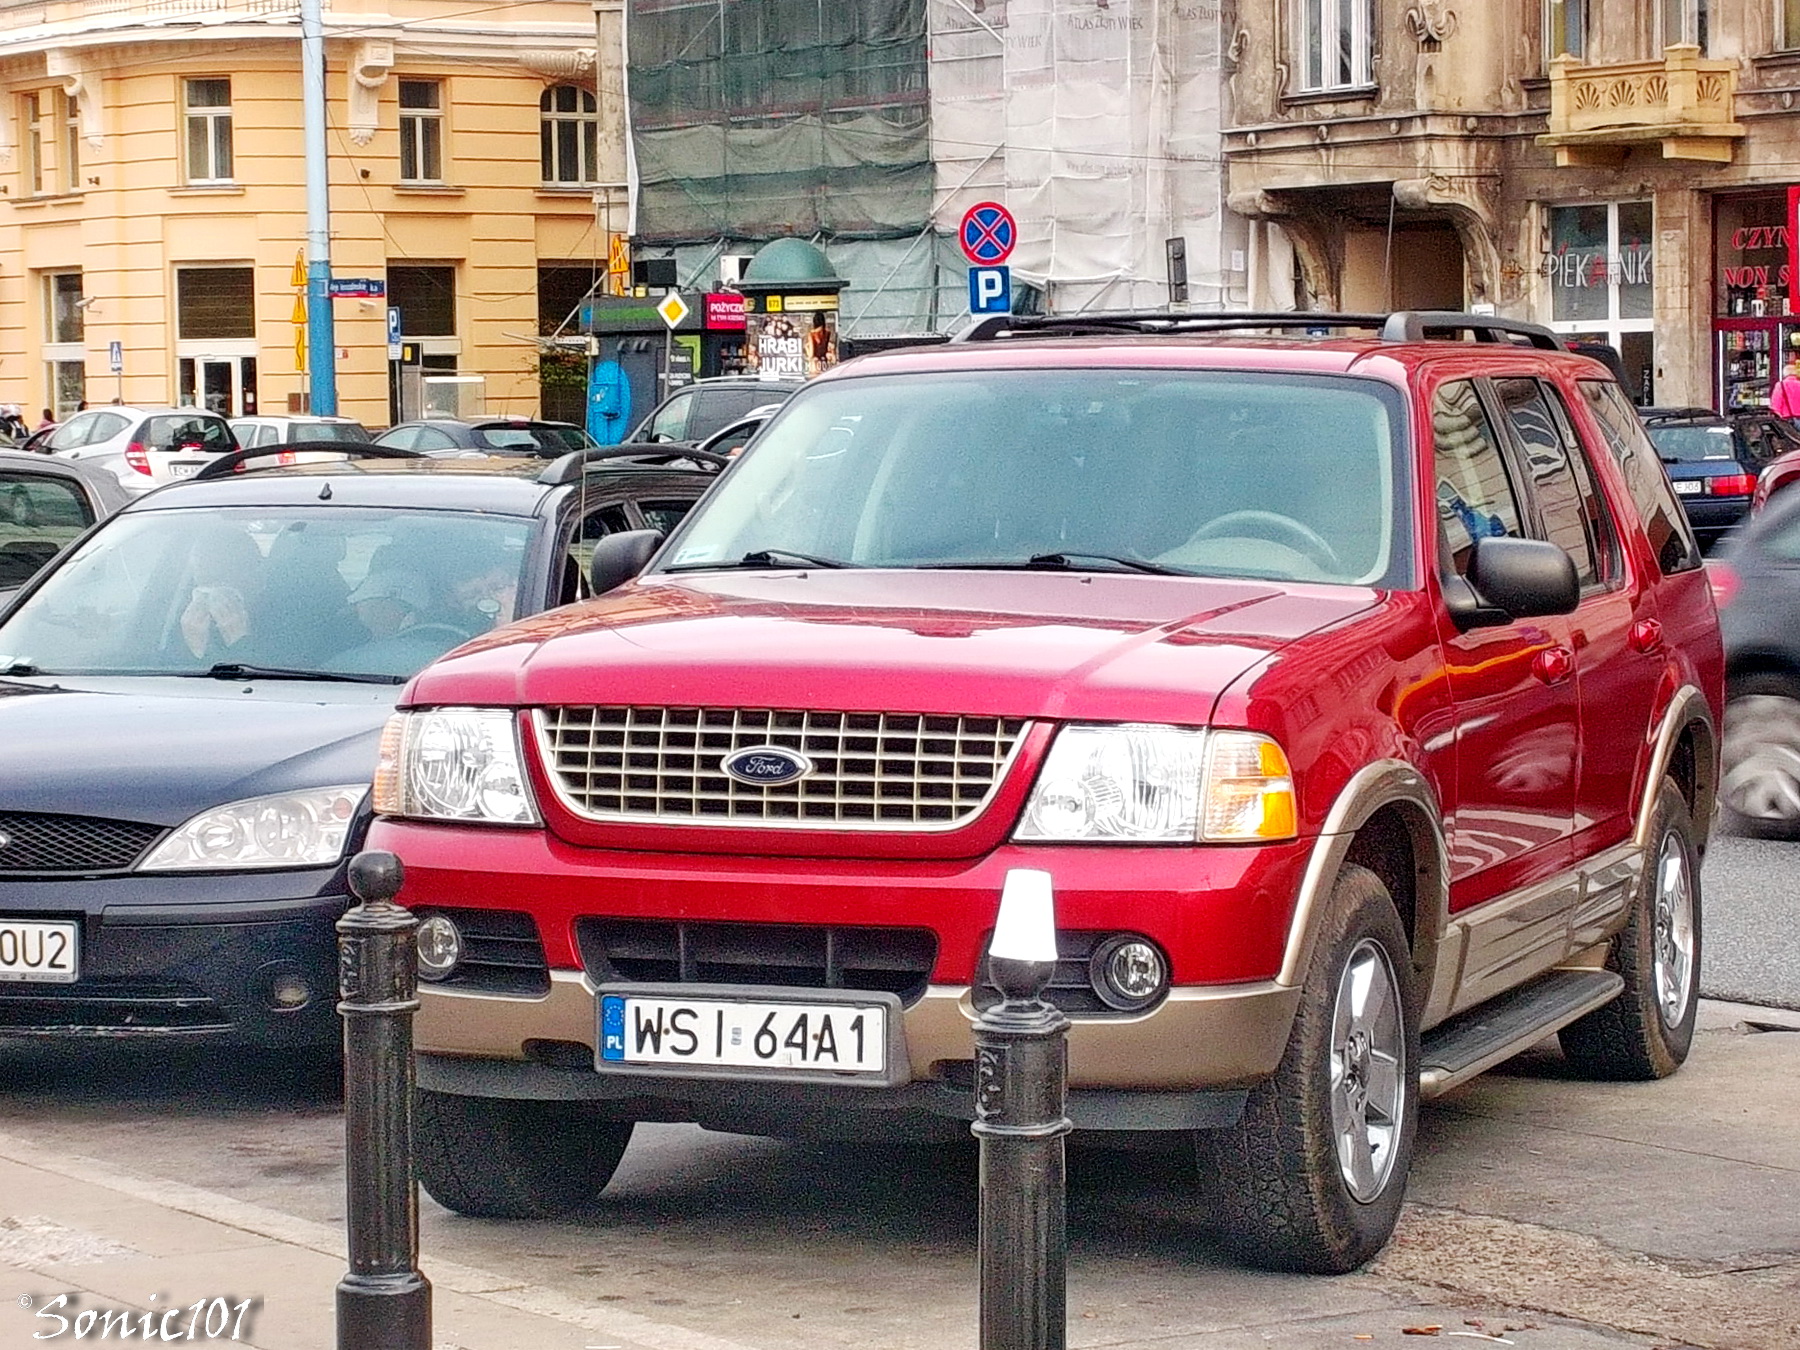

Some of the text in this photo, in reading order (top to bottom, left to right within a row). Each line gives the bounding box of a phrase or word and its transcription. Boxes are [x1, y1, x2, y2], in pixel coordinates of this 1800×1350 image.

[1723, 265, 1770, 288] NON
[978, 270, 1003, 308] P
[389, 310, 397, 333] P
[759, 338, 801, 354] HRABI
[758, 357, 802, 371] JURKI
[745, 756, 785, 775] Ford
[606, 1035, 623, 1050] PL
[635, 1006, 864, 1064] WSI 64A1
